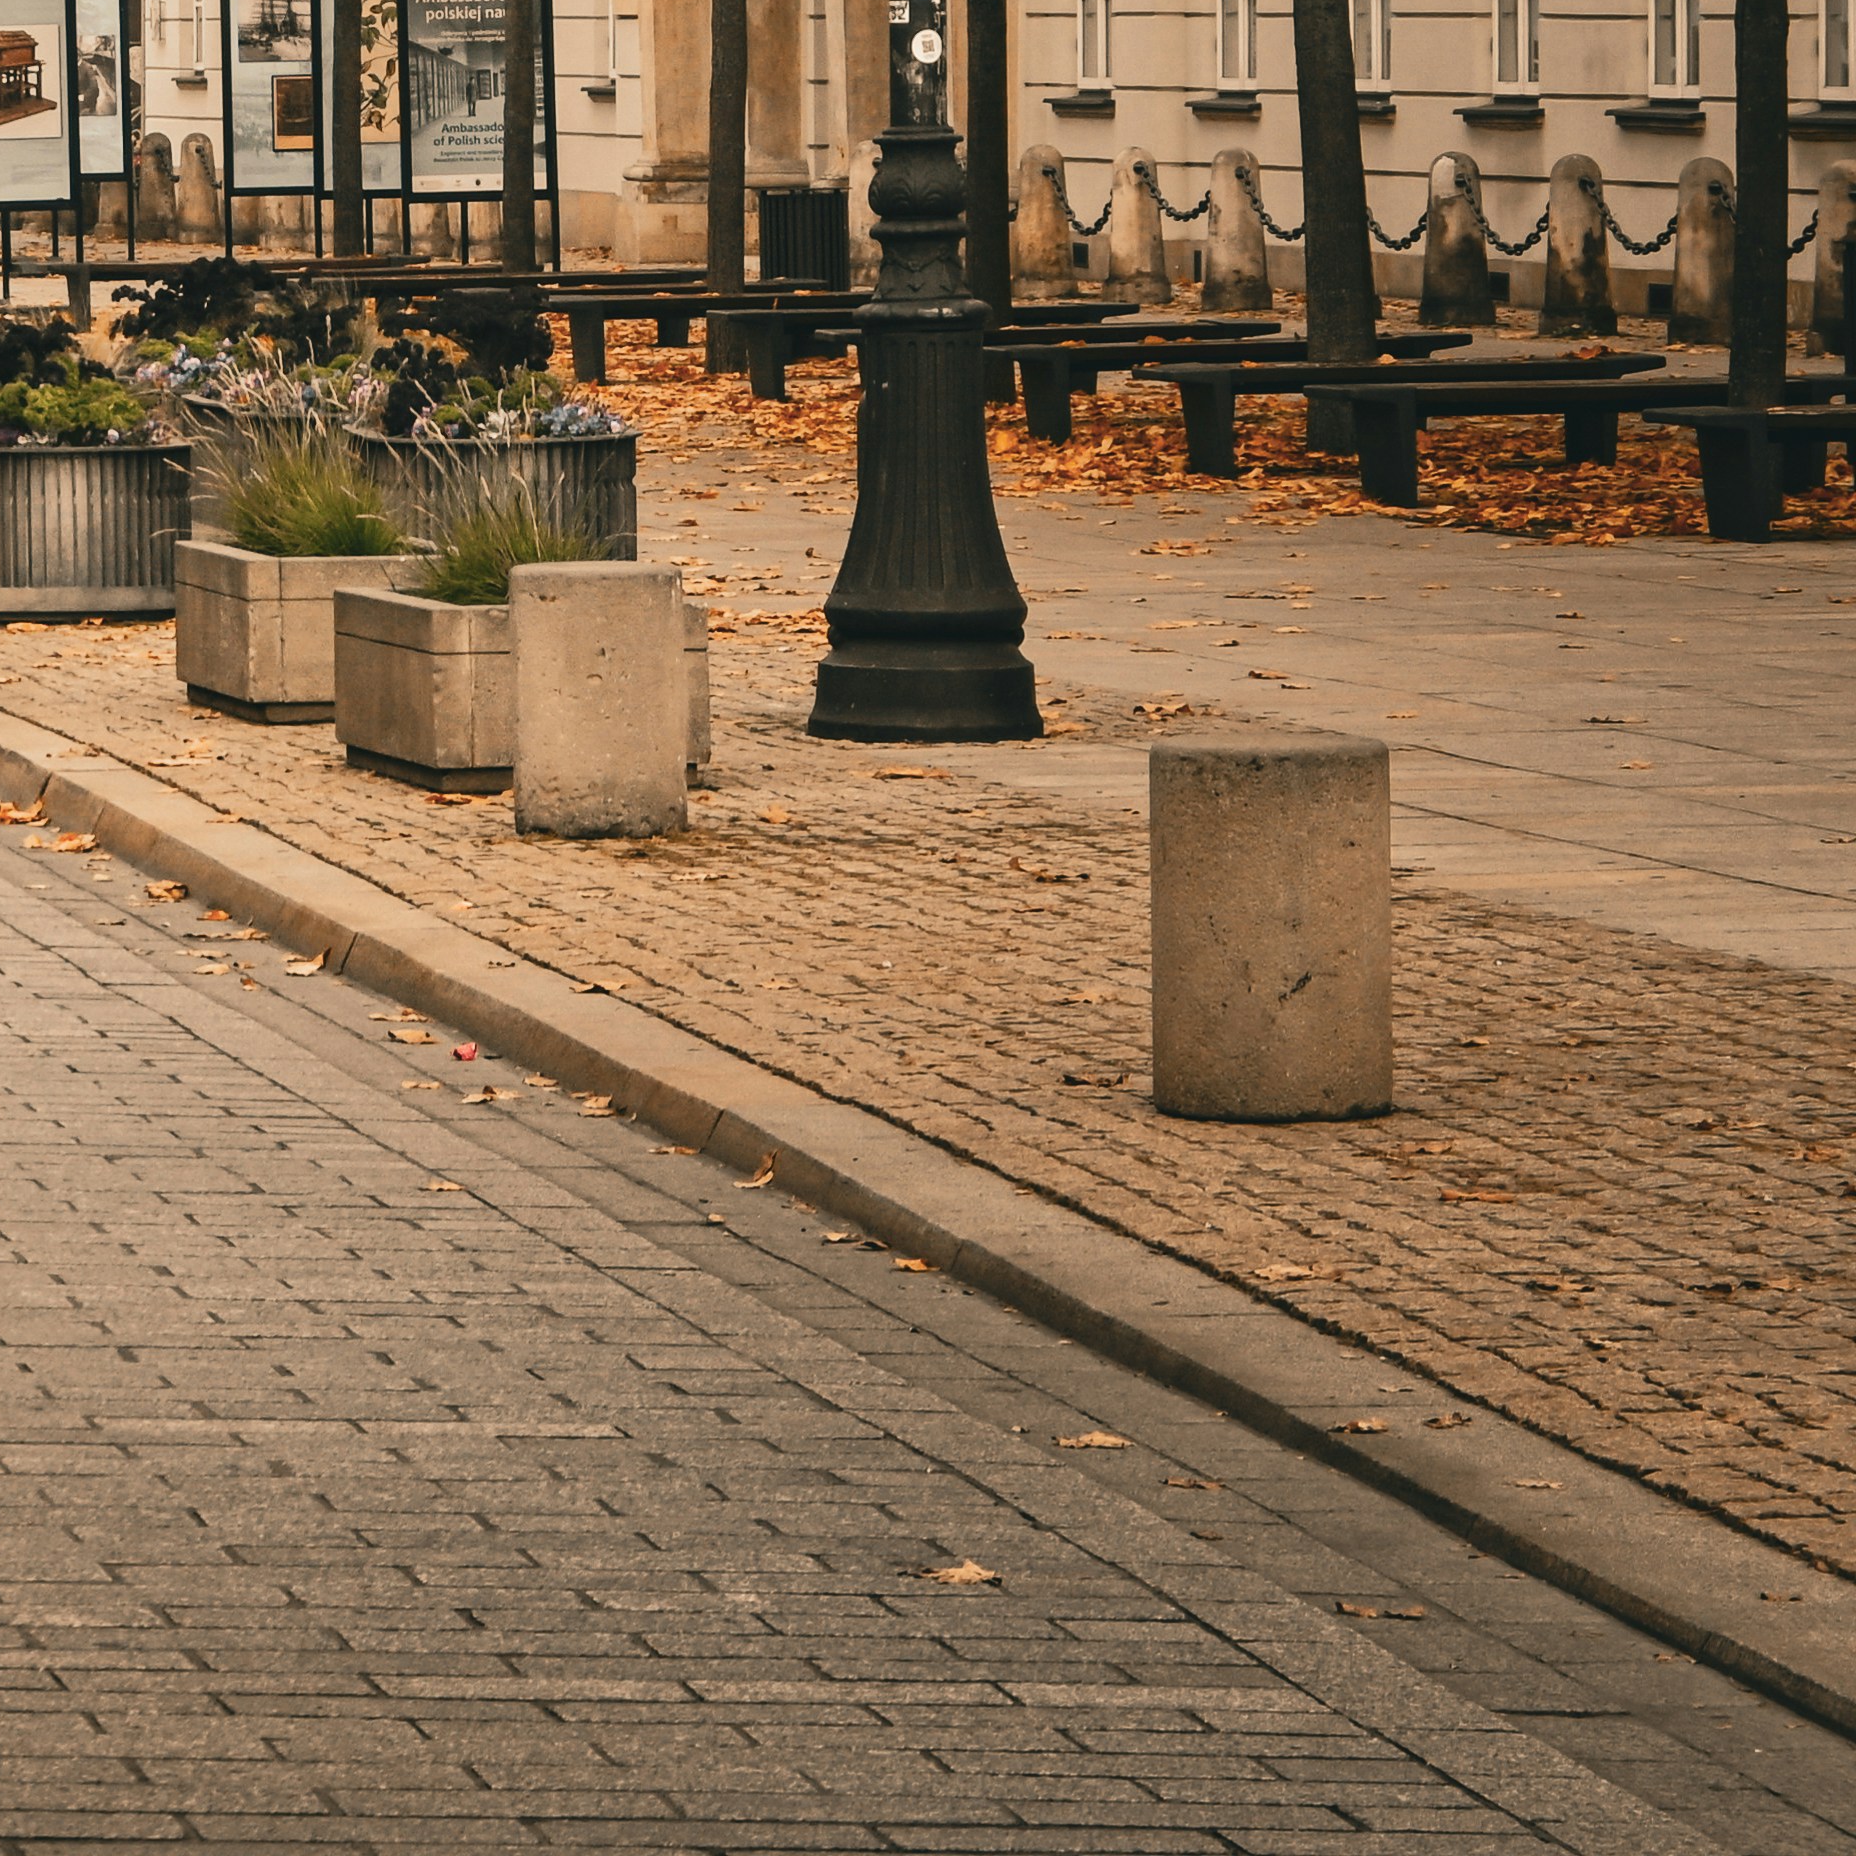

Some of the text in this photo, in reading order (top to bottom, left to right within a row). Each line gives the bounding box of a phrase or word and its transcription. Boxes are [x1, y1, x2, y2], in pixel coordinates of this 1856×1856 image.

[425, 6, 481, 24] polskiej
[433, 136, 445, 146] of
[448, 135, 481, 145] Polish
